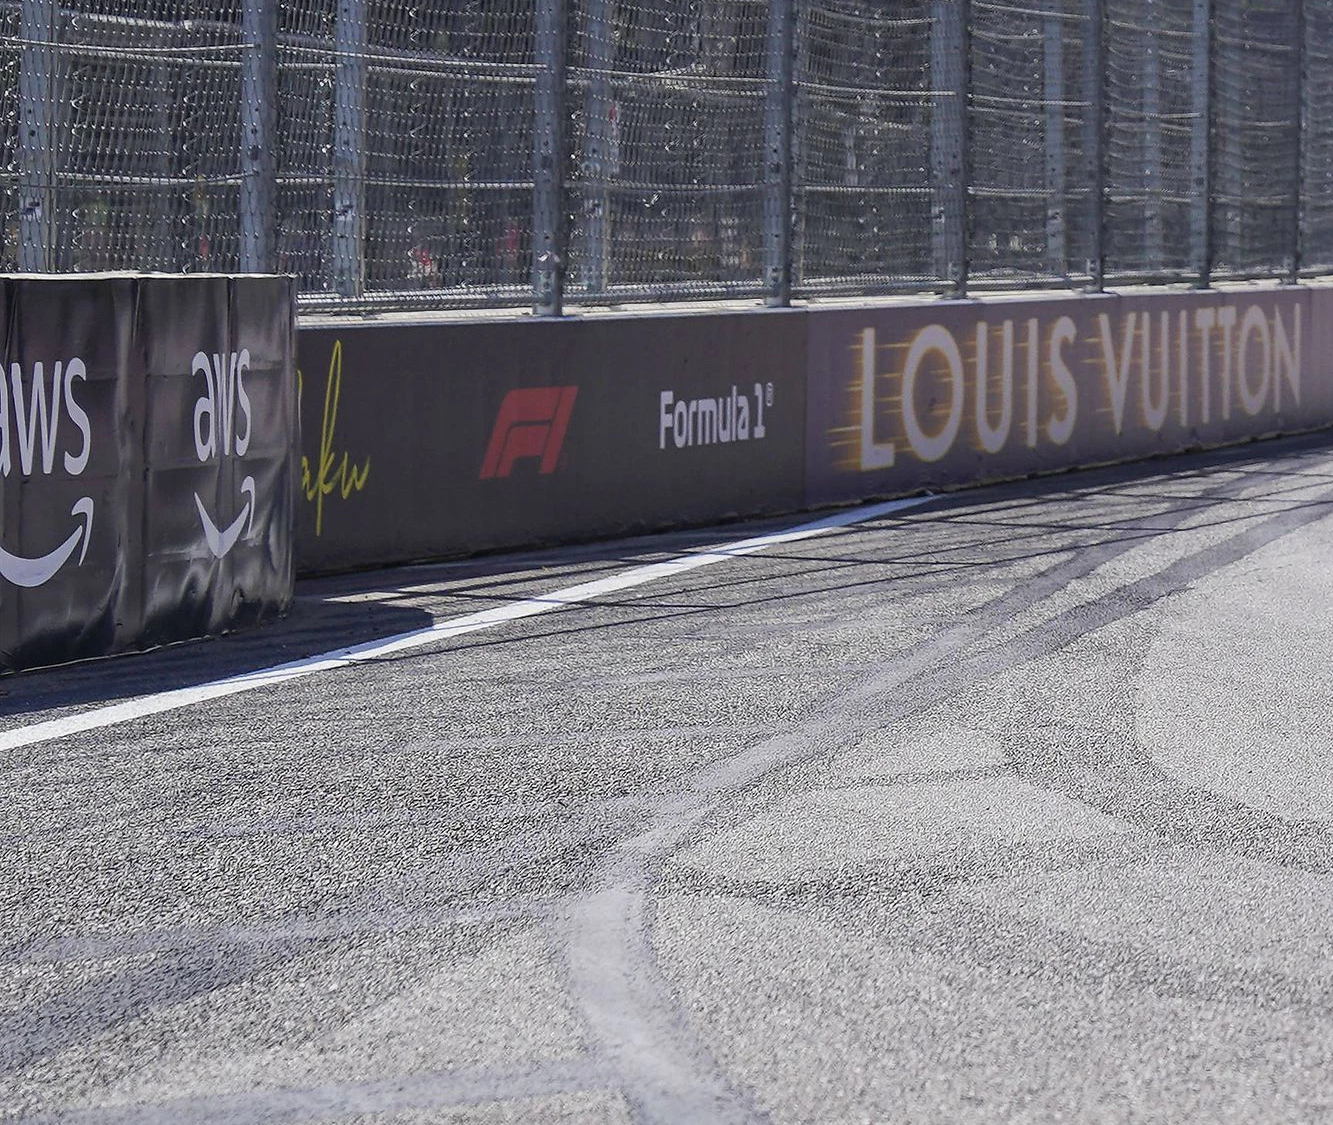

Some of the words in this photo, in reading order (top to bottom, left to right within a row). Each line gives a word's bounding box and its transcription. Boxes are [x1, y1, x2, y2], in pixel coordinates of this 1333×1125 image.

[191, 348, 251, 462] aws
[659, 384, 749, 450] Formula
[860, 316, 1078, 470] LOUIS
[1099, 303, 1301, 435] VUITTON
